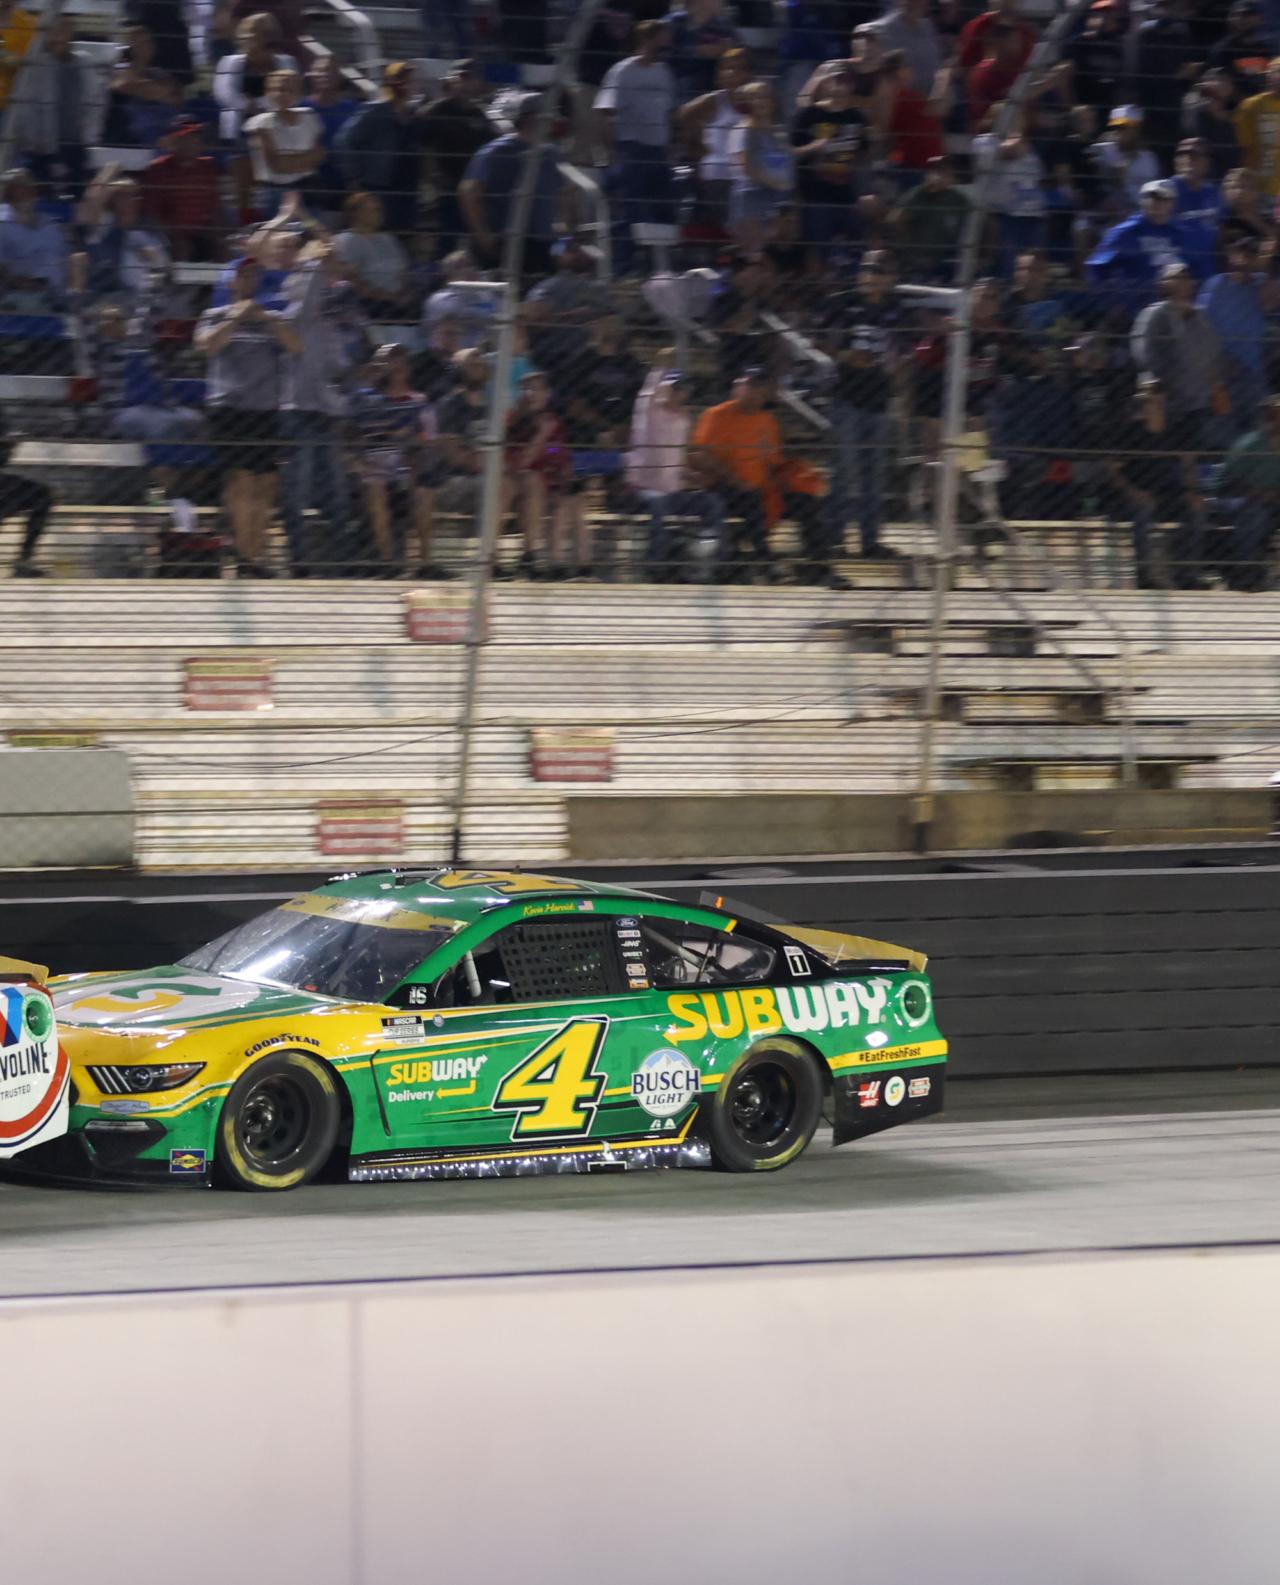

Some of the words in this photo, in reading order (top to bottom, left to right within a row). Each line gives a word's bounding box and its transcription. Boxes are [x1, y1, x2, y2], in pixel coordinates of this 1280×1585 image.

[662, 976, 894, 1047] SUBWAY
[244, 1033, 320, 1057] GOODYEAR
[859, 1047, 921, 1062] #EatFreshFast
[386, 1055, 488, 1086] SUBWAY
[491, 1015, 610, 1142] 4
[633, 1069, 700, 1095] BUSCH
[0, 1084, 32, 1100] TRUSTED
[388, 1089, 434, 1102] Delivery
[646, 1092, 685, 1105] LIGHT
